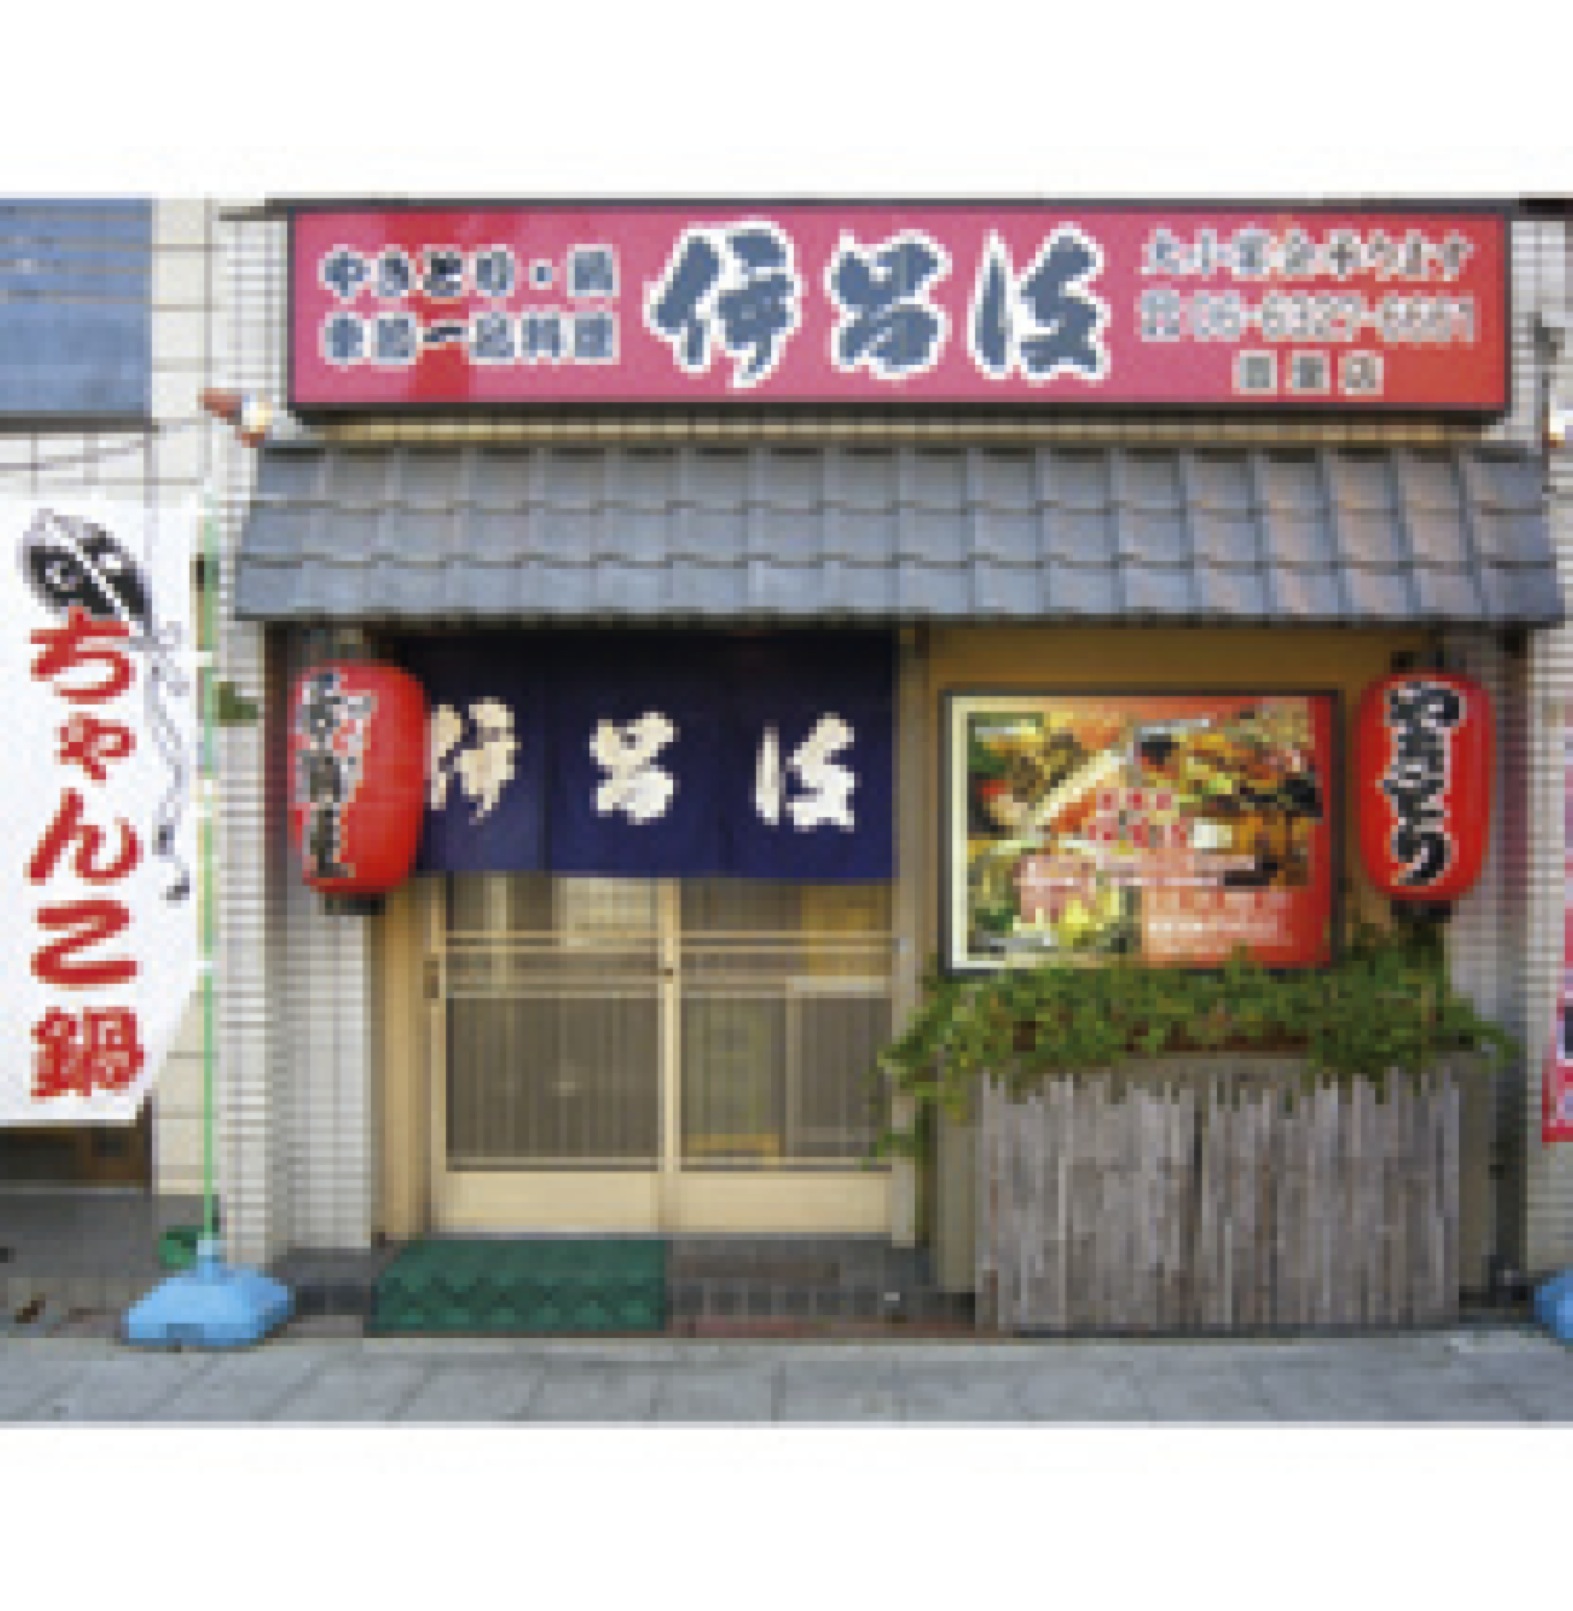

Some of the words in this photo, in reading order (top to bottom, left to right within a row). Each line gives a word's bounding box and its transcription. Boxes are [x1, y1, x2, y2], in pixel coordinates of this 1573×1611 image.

[646, 222, 1112, 390] 伊呂波
[430, 696, 856, 832] 伊呂波
[26, 606, 144, 1098] ちゃんこ鍋
